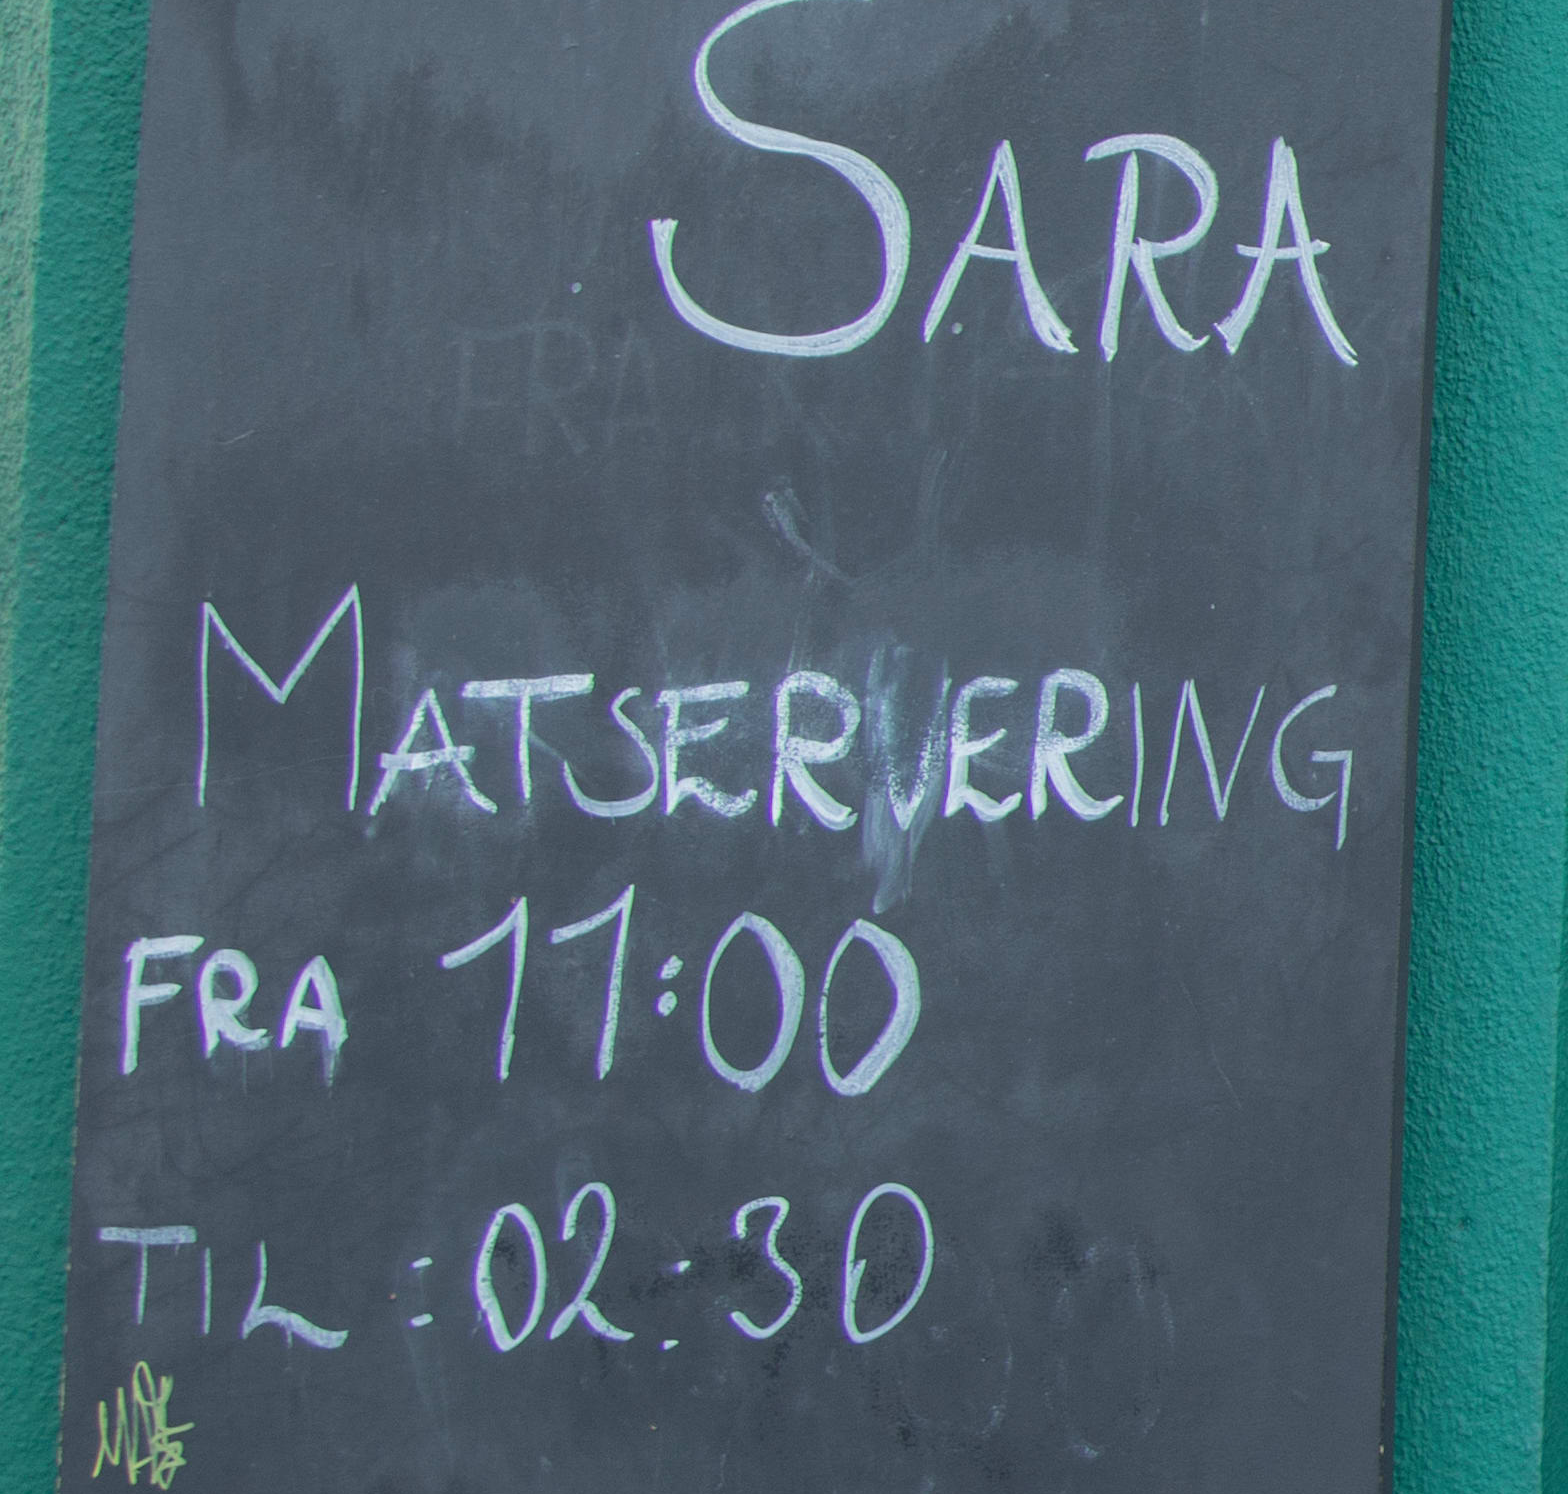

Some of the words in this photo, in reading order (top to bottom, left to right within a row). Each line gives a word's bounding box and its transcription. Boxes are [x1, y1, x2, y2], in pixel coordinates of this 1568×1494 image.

[199, 585, 1352, 849] MATSERVERING
[121, 935, 346, 1077] FRA
[443, 884, 919, 1095] 11:00
[100, 1226, 348, 1349] TIL
